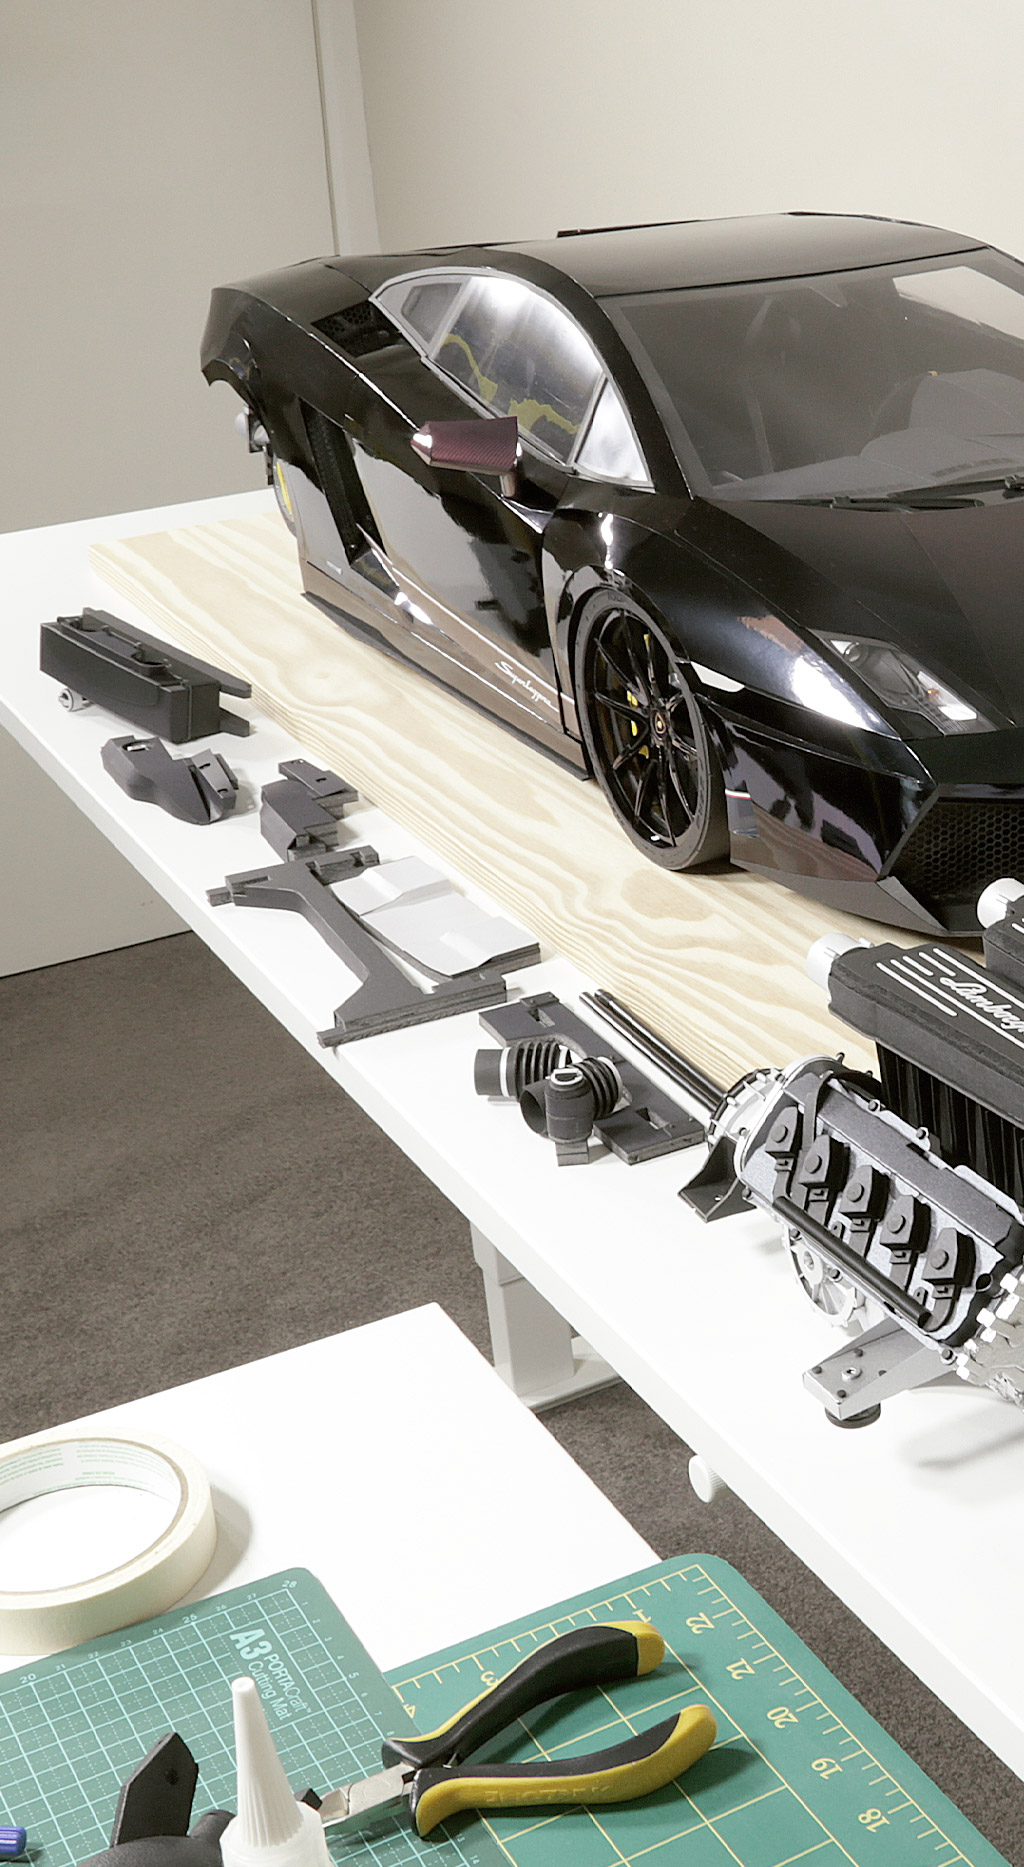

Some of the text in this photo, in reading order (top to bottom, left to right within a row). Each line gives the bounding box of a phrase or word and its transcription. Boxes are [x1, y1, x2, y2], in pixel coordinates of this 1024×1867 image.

[19, 1673, 37, 1684] 20
[181, 1613, 198, 1625] 25
[281, 1580, 297, 1590] 28
[685, 1612, 715, 1634] 22
[229, 1628, 273, 1660] A3
[725, 1657, 756, 1680] 21
[248, 1660, 293, 1721] Cutting Mat
[766, 1706, 799, 1729] 20
[811, 1757, 843, 1780] 19
[858, 1807, 891, 1833] 18
